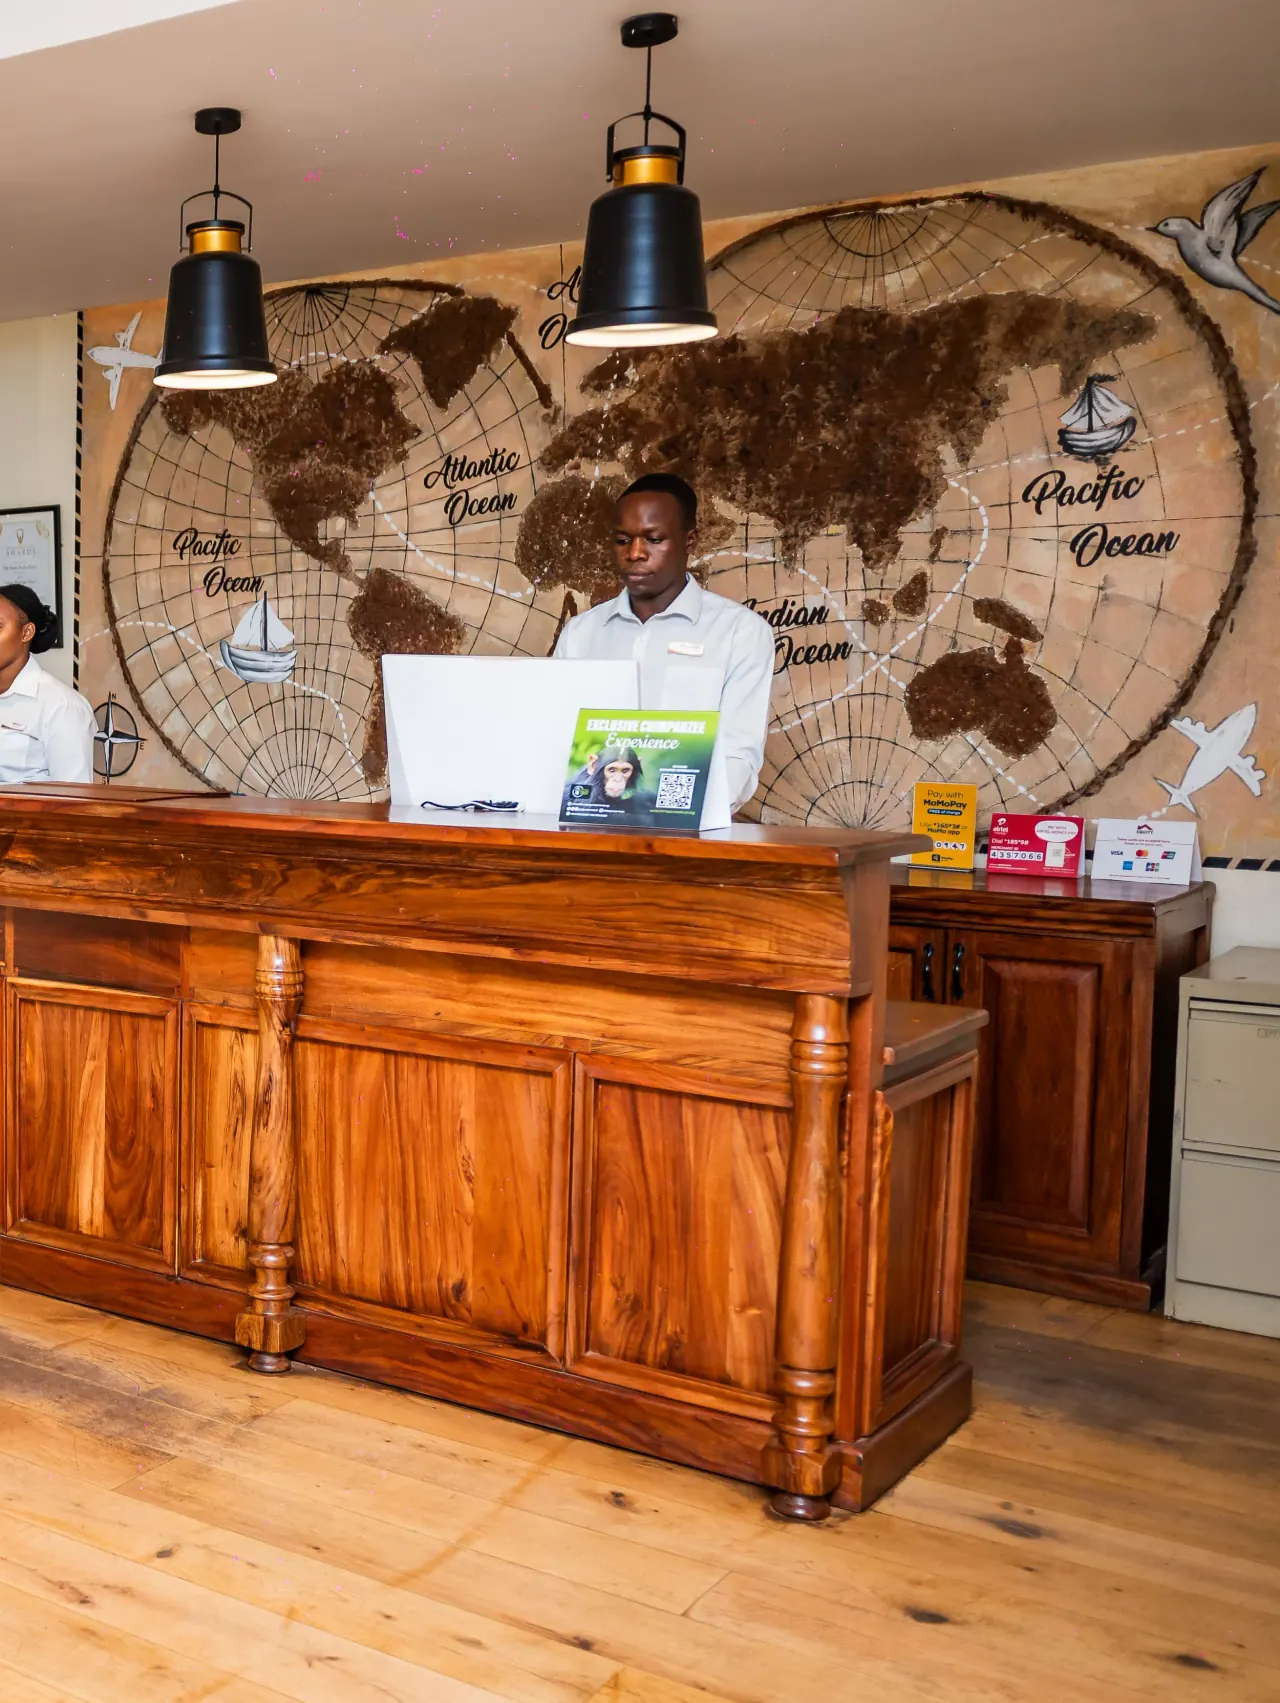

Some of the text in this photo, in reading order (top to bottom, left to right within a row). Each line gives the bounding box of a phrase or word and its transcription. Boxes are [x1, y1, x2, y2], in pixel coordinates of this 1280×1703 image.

[423, 447, 520, 489] Atlantic
[1021, 464, 1145, 516] Pacific
[443, 488, 518, 526] Ocean
[172, 527, 242, 563] Pacific
[1069, 522, 1181, 568] Ocean
[202, 565, 265, 598] Ocean
[773, 634, 854, 676] Ocean
[111, 692, 117, 700] N
[586, 719, 639, 732] EXCLUSIVE
[139, 742, 145, 750] E
[604, 732, 680, 755] Experience
[101, 776, 107, 785] S
[923, 799, 968, 810] MoMoPay
[927, 789, 964, 799] Pay with
[990, 851, 1042, 860] 4357066
